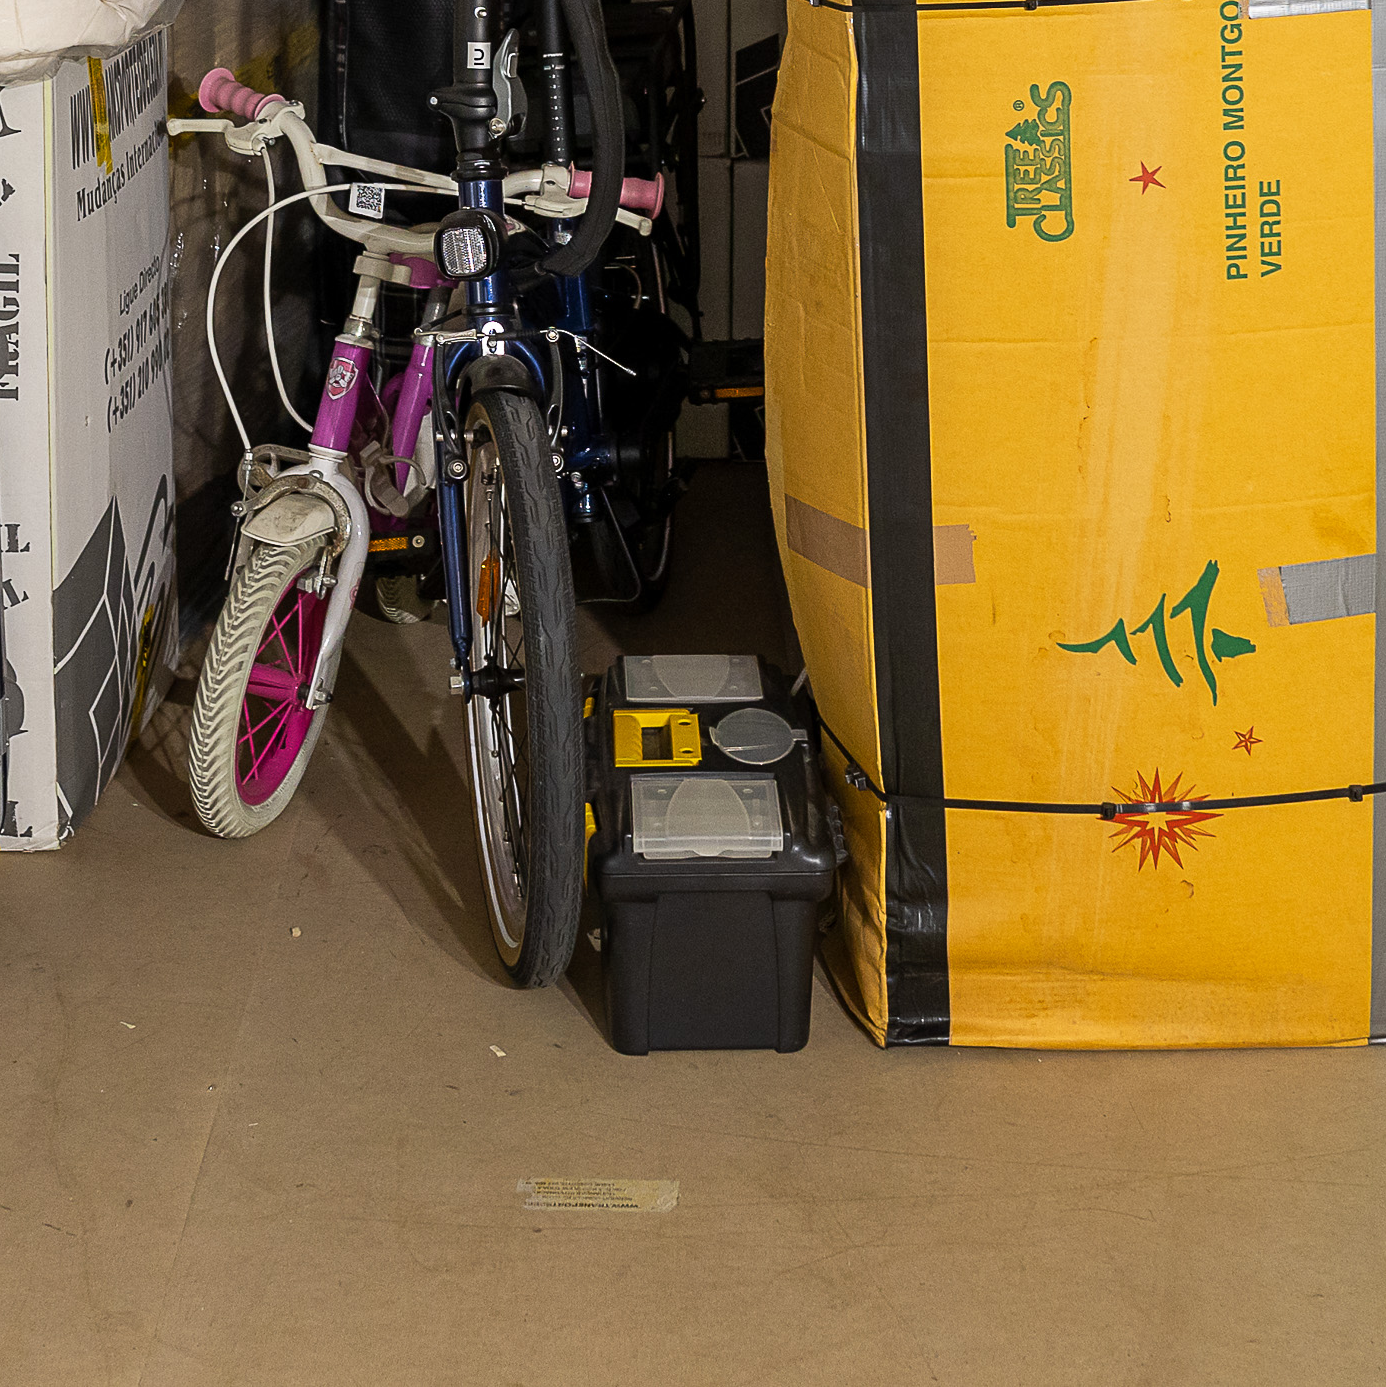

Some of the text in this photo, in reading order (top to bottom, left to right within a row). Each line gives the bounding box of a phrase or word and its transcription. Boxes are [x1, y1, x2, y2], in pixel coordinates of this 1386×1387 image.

[76, 161, 127, 222] Mudanças
[1004, 143, 1043, 229] TREE
[1029, 80, 1075, 243] CLASSICS
[1223, 140, 1248, 281] PINHEIRO
[1258, 179, 1283, 278] VERDE
[119, 282, 140, 316] Ligue
[104, 325, 135, 385] (+351)
[107, 372, 137, 434] (+351)
